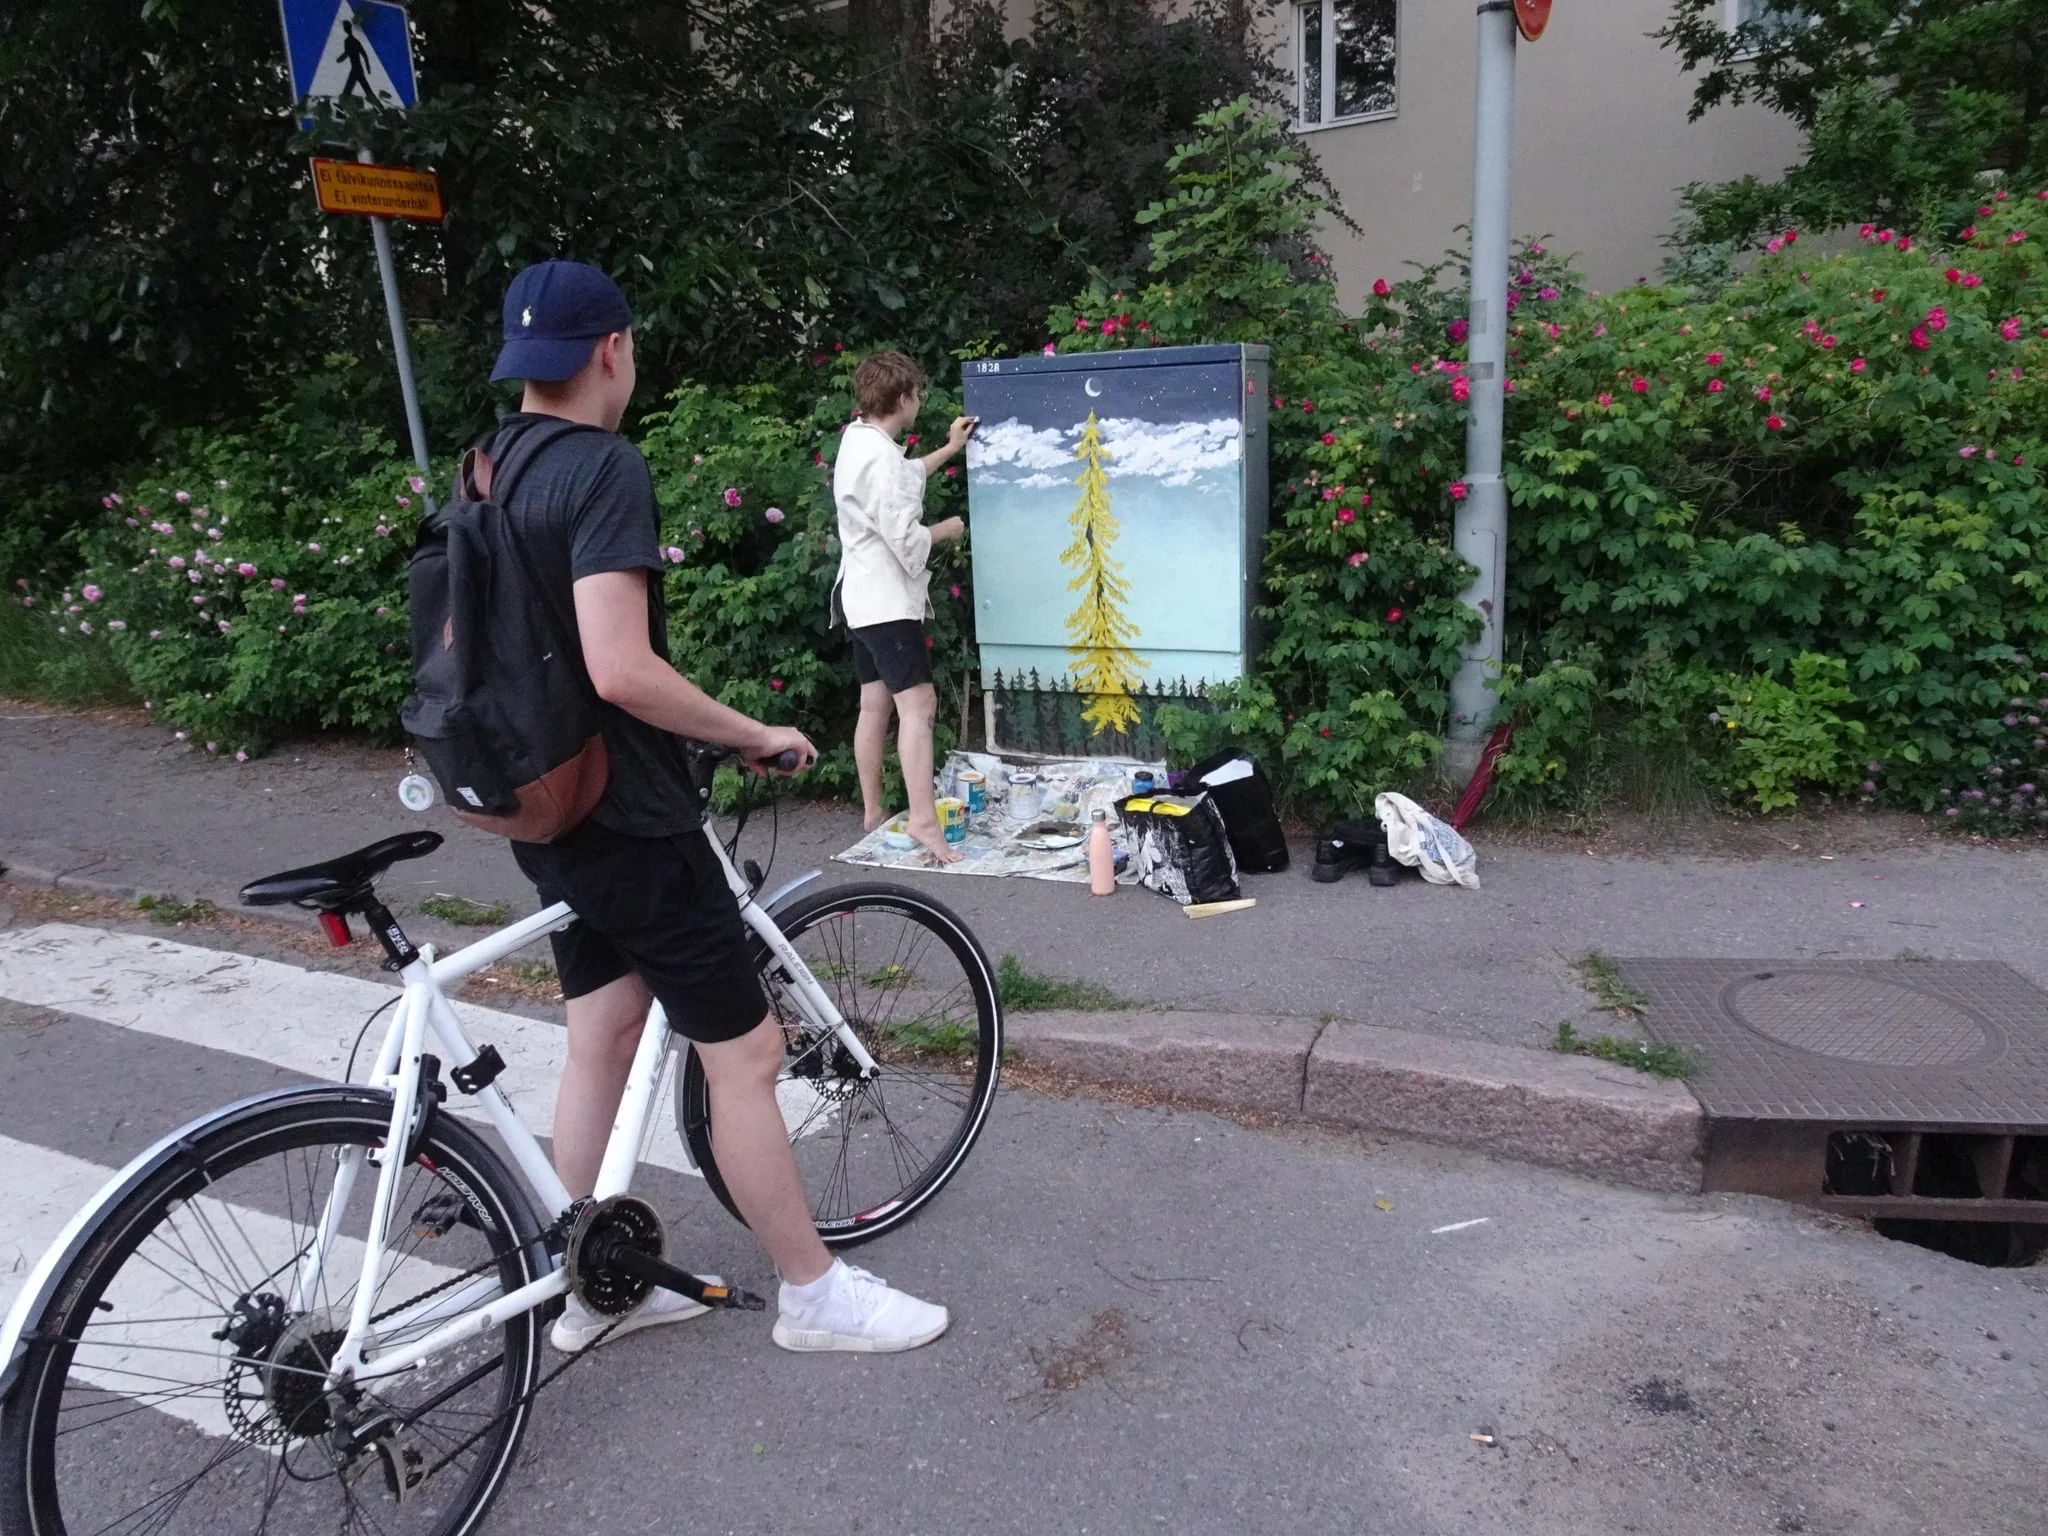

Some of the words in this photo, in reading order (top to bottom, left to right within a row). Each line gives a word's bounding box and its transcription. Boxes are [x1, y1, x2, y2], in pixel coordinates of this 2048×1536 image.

[320, 169, 332, 183] Ei
[335, 190, 347, 205] Ej
[976, 362, 1000, 373] 1828
[776, 944, 814, 984] RALEIGH
[437, 1167, 492, 1221] RALEIGH
